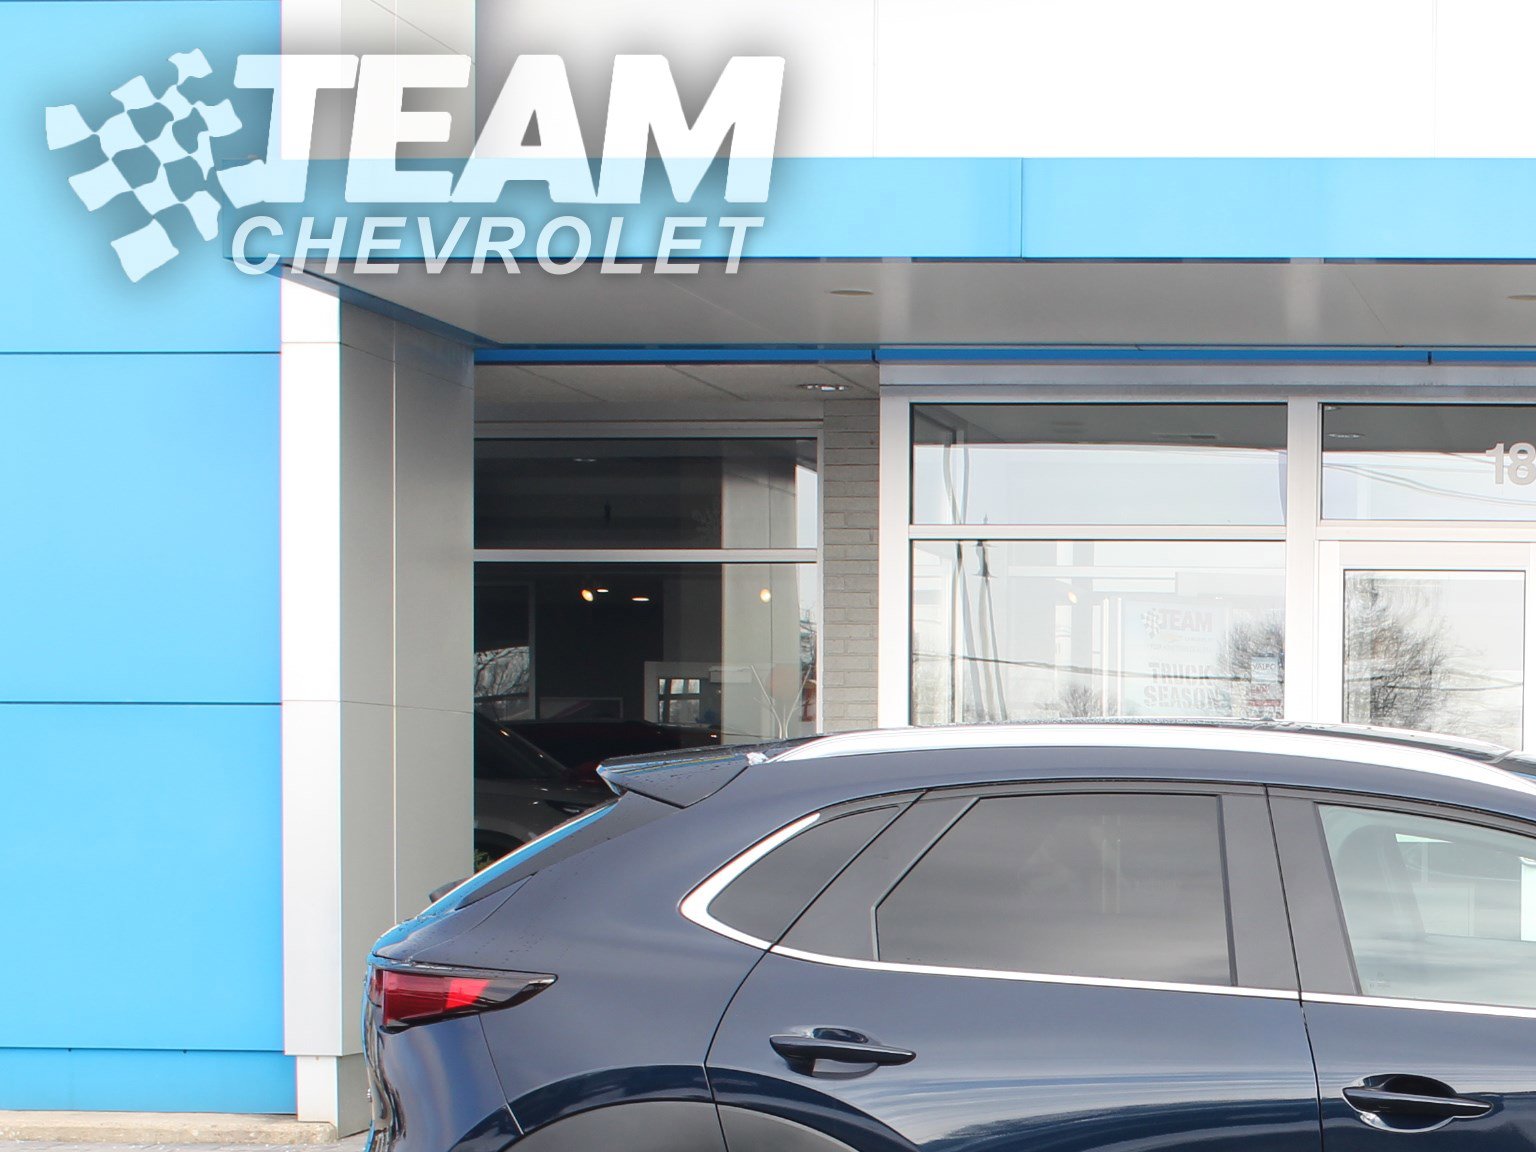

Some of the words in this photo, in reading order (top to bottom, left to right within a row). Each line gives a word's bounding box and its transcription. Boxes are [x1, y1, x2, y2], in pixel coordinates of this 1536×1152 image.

[1158, 608, 1213, 632] TEAM
[1148, 662, 1215, 686] TRUCK
[1143, 685, 1221, 710] SEASON
